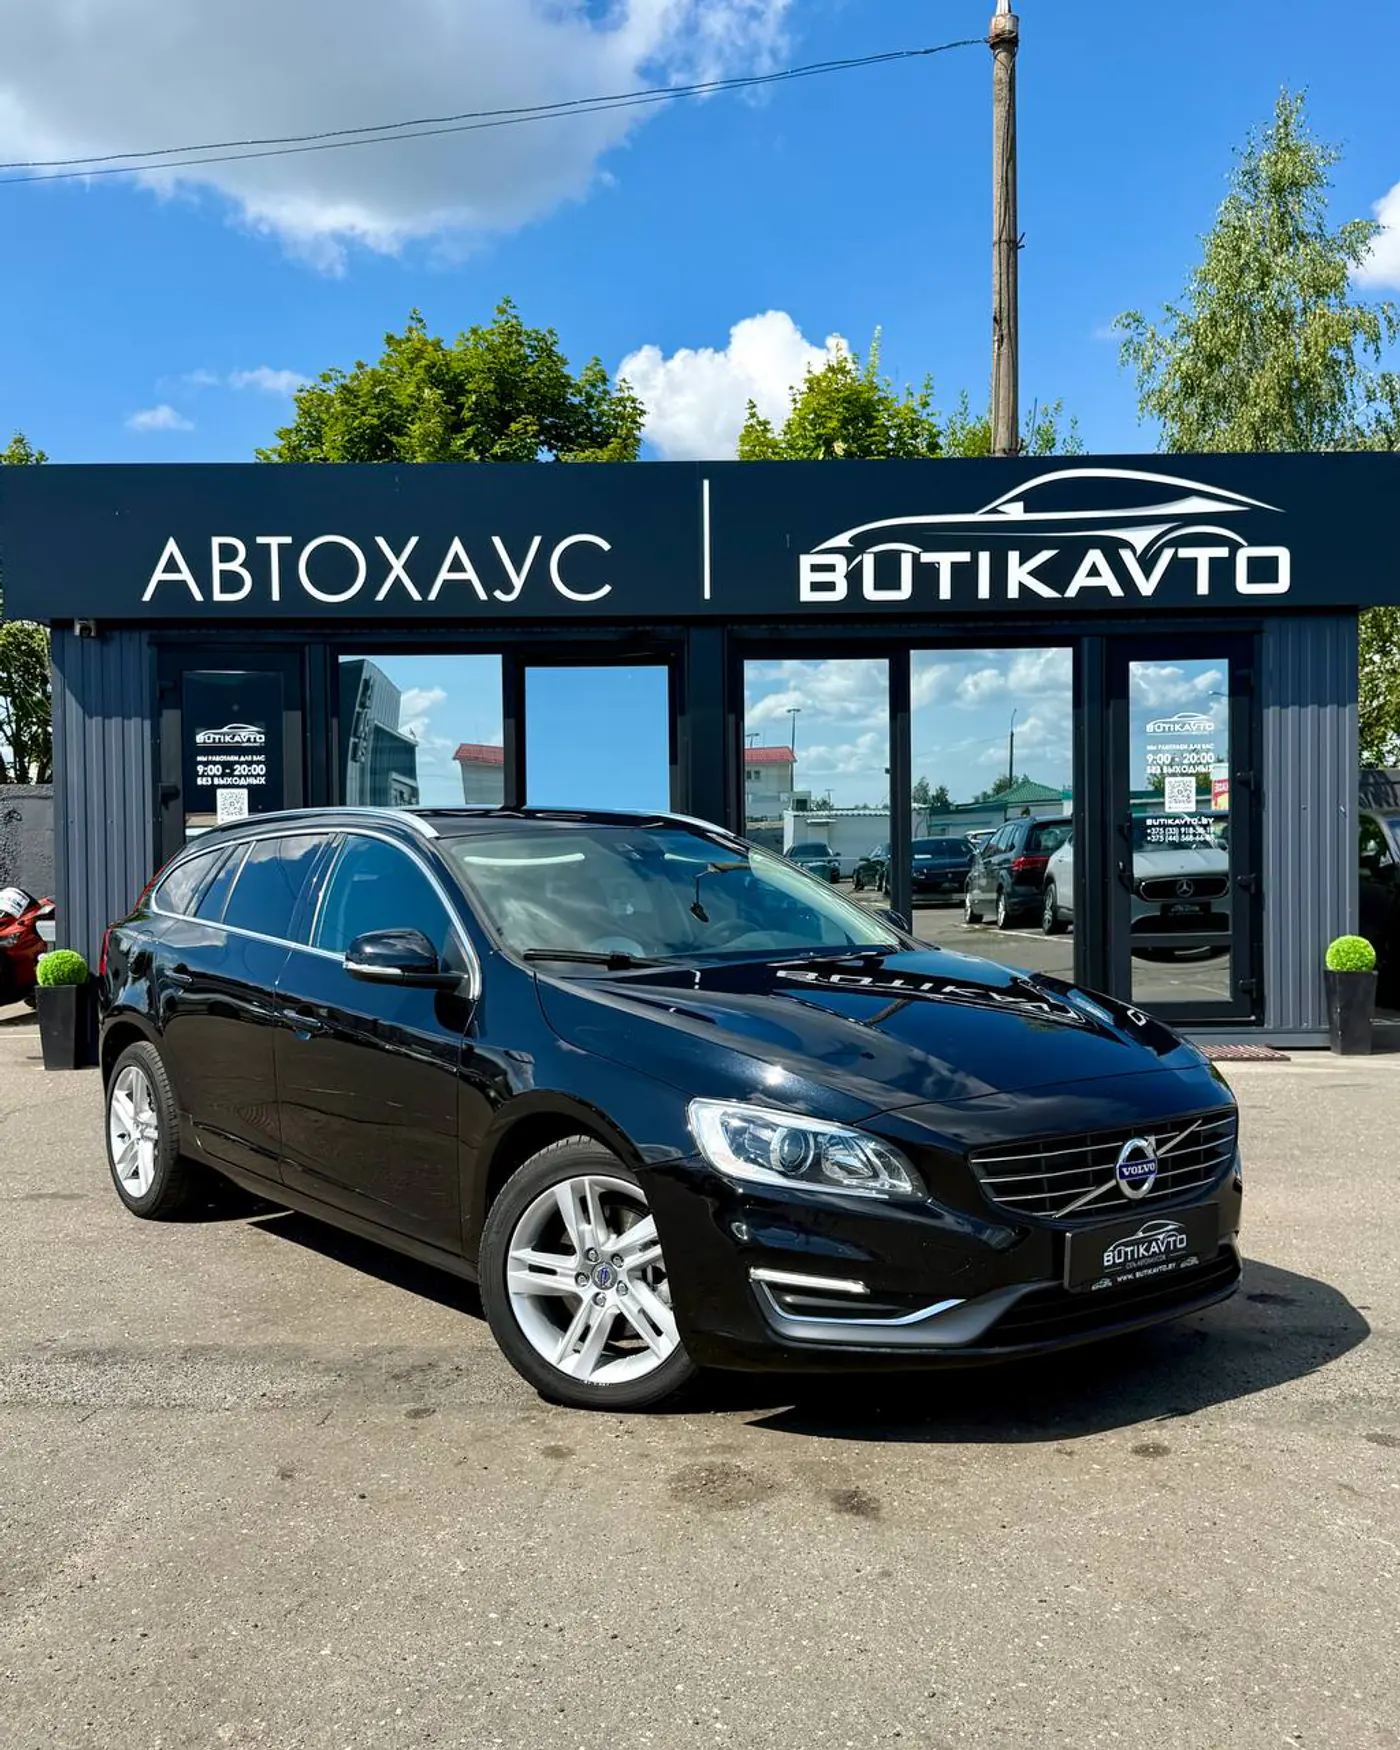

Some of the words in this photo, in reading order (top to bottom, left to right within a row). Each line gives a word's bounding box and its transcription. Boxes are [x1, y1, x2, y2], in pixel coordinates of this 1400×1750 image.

[142, 534, 612, 602] АВТОХАУС
[799, 545, 1291, 602] BUTIKAVTO
[1146, 722, 1214, 732] BUTIKAVTO
[196, 734, 265, 743] BUTIKAVTO
[1146, 753, 1171, 764] 9:00
[1182, 752, 1215, 764] 20:00
[197, 764, 222, 775] 9:00
[233, 764, 266, 775] 20:00
[1163, 764, 1214, 774] ВЫХОДНЫХ
[197, 777, 212, 785] БЕЗ
[213, 777, 266, 785] ВЫХОДНЫХ
[1146, 816, 1214, 826] BUTIKAVTO.BY
[1122, 1162, 1155, 1175] VOLVO
[1103, 1234, 1187, 1265] BUTIKAVTO
